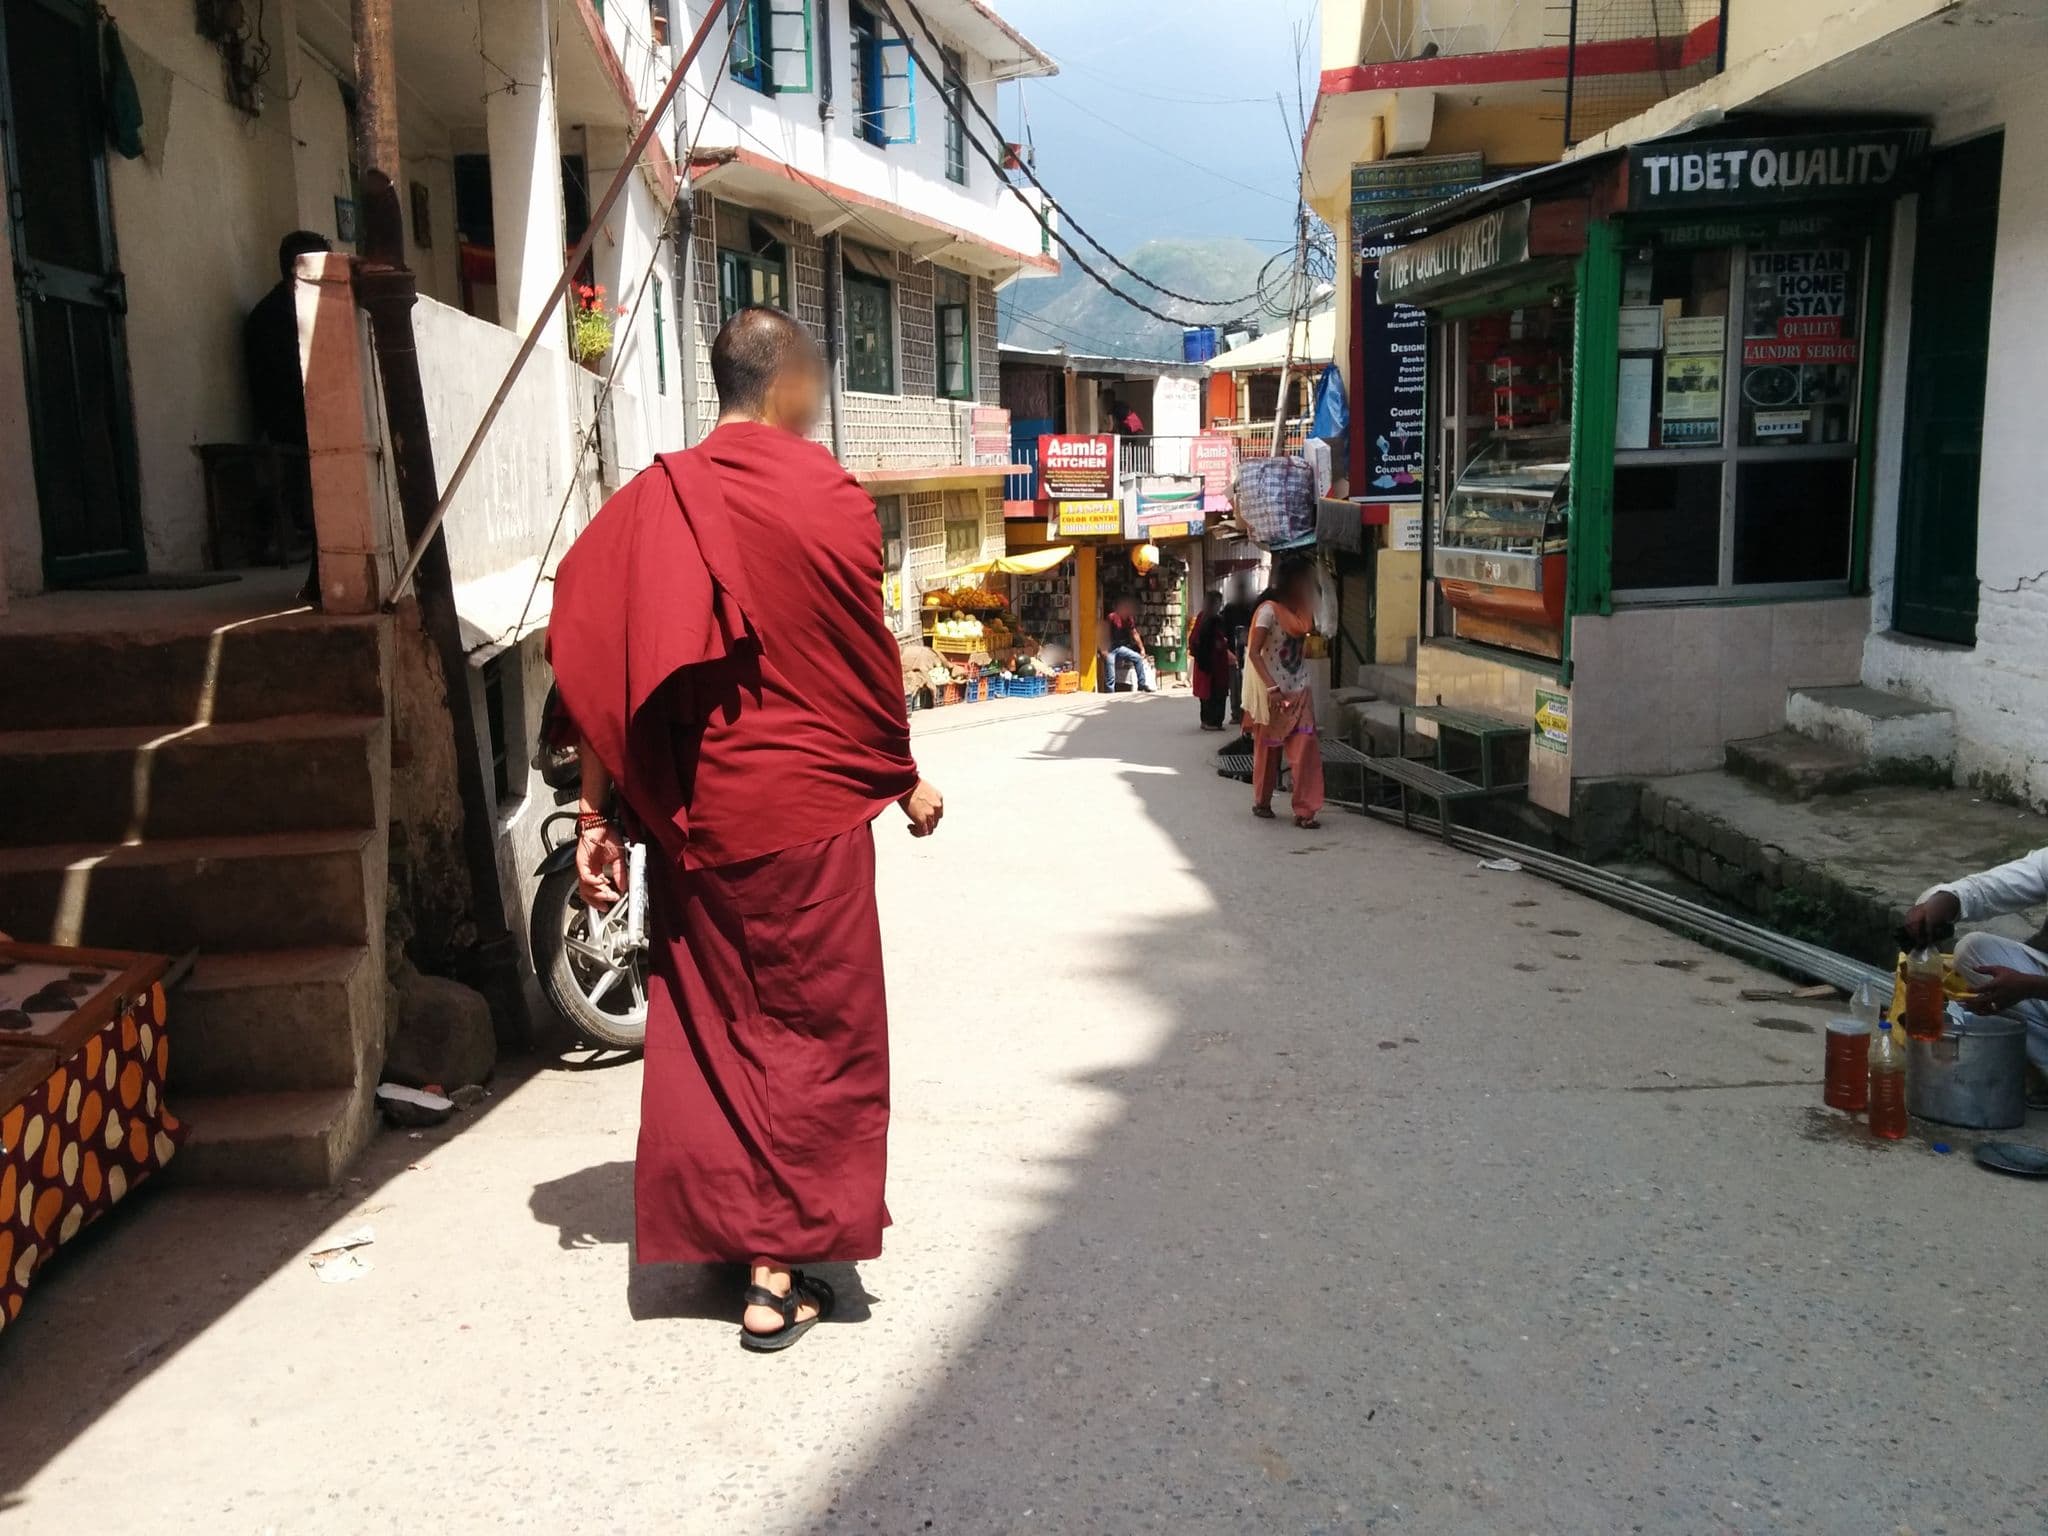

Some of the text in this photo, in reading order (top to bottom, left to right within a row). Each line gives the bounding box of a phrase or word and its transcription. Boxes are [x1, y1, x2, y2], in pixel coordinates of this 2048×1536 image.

[1642, 144, 1899, 195] TIBET QUALITY
[1390, 211, 1505, 291] TIBET QUALITY BAKERY
[1751, 250, 1843, 274] TIBETAN
[1780, 274, 1842, 295] HOME
[1786, 295, 1843, 316] STAY
[1783, 321, 1839, 338] QUALITY
[1744, 345, 1801, 359] LAUNDRY
[1758, 423, 1800, 431] COFFEE
[1047, 438, 1107, 456] Aamla
[1196, 444, 1227, 458] Aamla
[1047, 457, 1106, 468] KITCHEN
